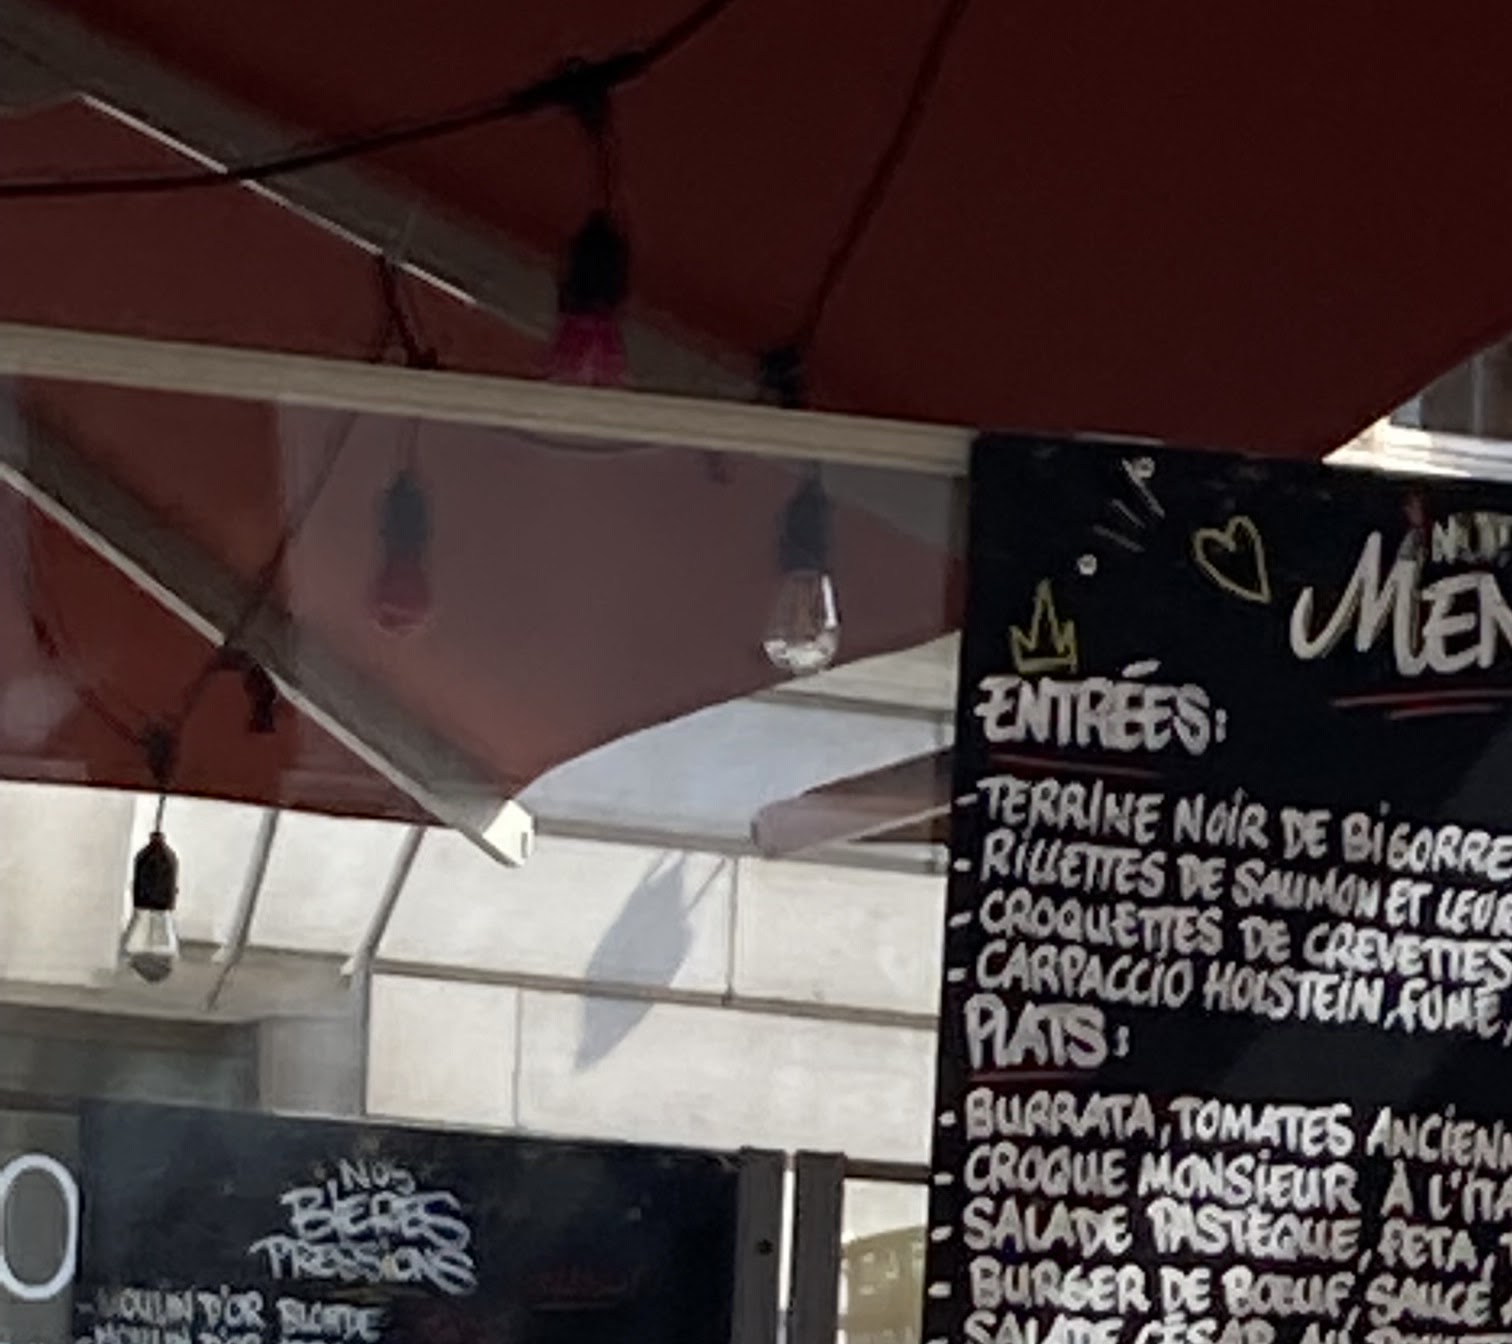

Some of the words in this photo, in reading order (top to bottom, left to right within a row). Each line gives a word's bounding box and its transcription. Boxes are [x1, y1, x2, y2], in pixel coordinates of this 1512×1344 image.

[977, 774, 1164, 843] TERRINE
[1174, 787, 1268, 848] NOIR
[1280, 807, 1332, 859] DE
[981, 828, 1166, 897] RILLETTES
[1177, 854, 1226, 899] DE
[1231, 858, 1380, 921] SAUMON
[1384, 879, 1432, 927] ET
[979, 887, 1223, 958] CROQUETTES
[1238, 915, 1291, 962] DE
[976, 940, 1194, 1008] CARPACCIO
[1169, 1096, 1355, 1156] TOMATES
[339, 1157, 417, 1195] NOS
[964, 1140, 1129, 1198] CROQUE
[1137, 1148, 1361, 1213] MONSIEUR
[963, 1196, 1133, 1257] SALADE
[970, 1254, 1150, 1313] BURGER
[1159, 1264, 1213, 1312] DE
[1365, 1272, 1492, 1326] SAUCE
